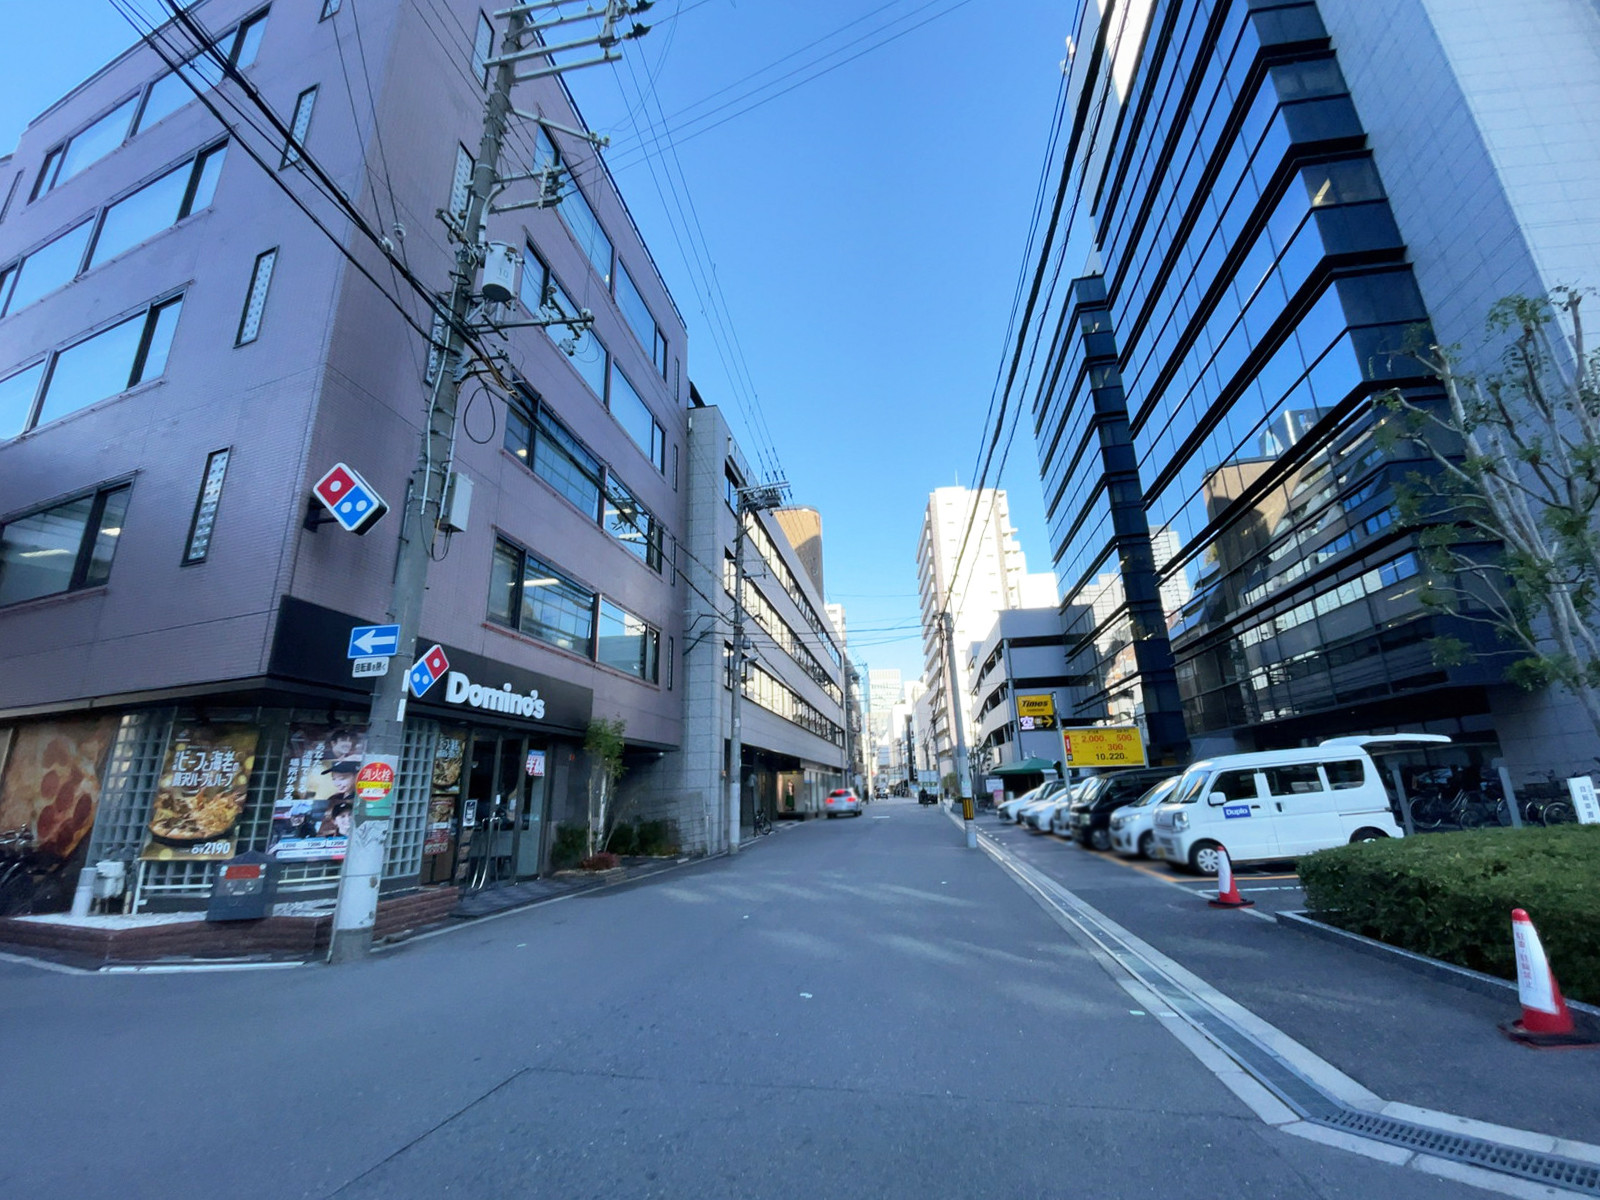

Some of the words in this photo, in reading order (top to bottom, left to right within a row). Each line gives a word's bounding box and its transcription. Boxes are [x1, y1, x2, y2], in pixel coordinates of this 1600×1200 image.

[355, 661, 387, 673] 自転車を除く
[445, 671, 545, 719] Domino's
[1022, 699, 1049, 708] Times
[361, 768, 391, 782] 消火栓
[1225, 807, 1248, 816] Duplo
